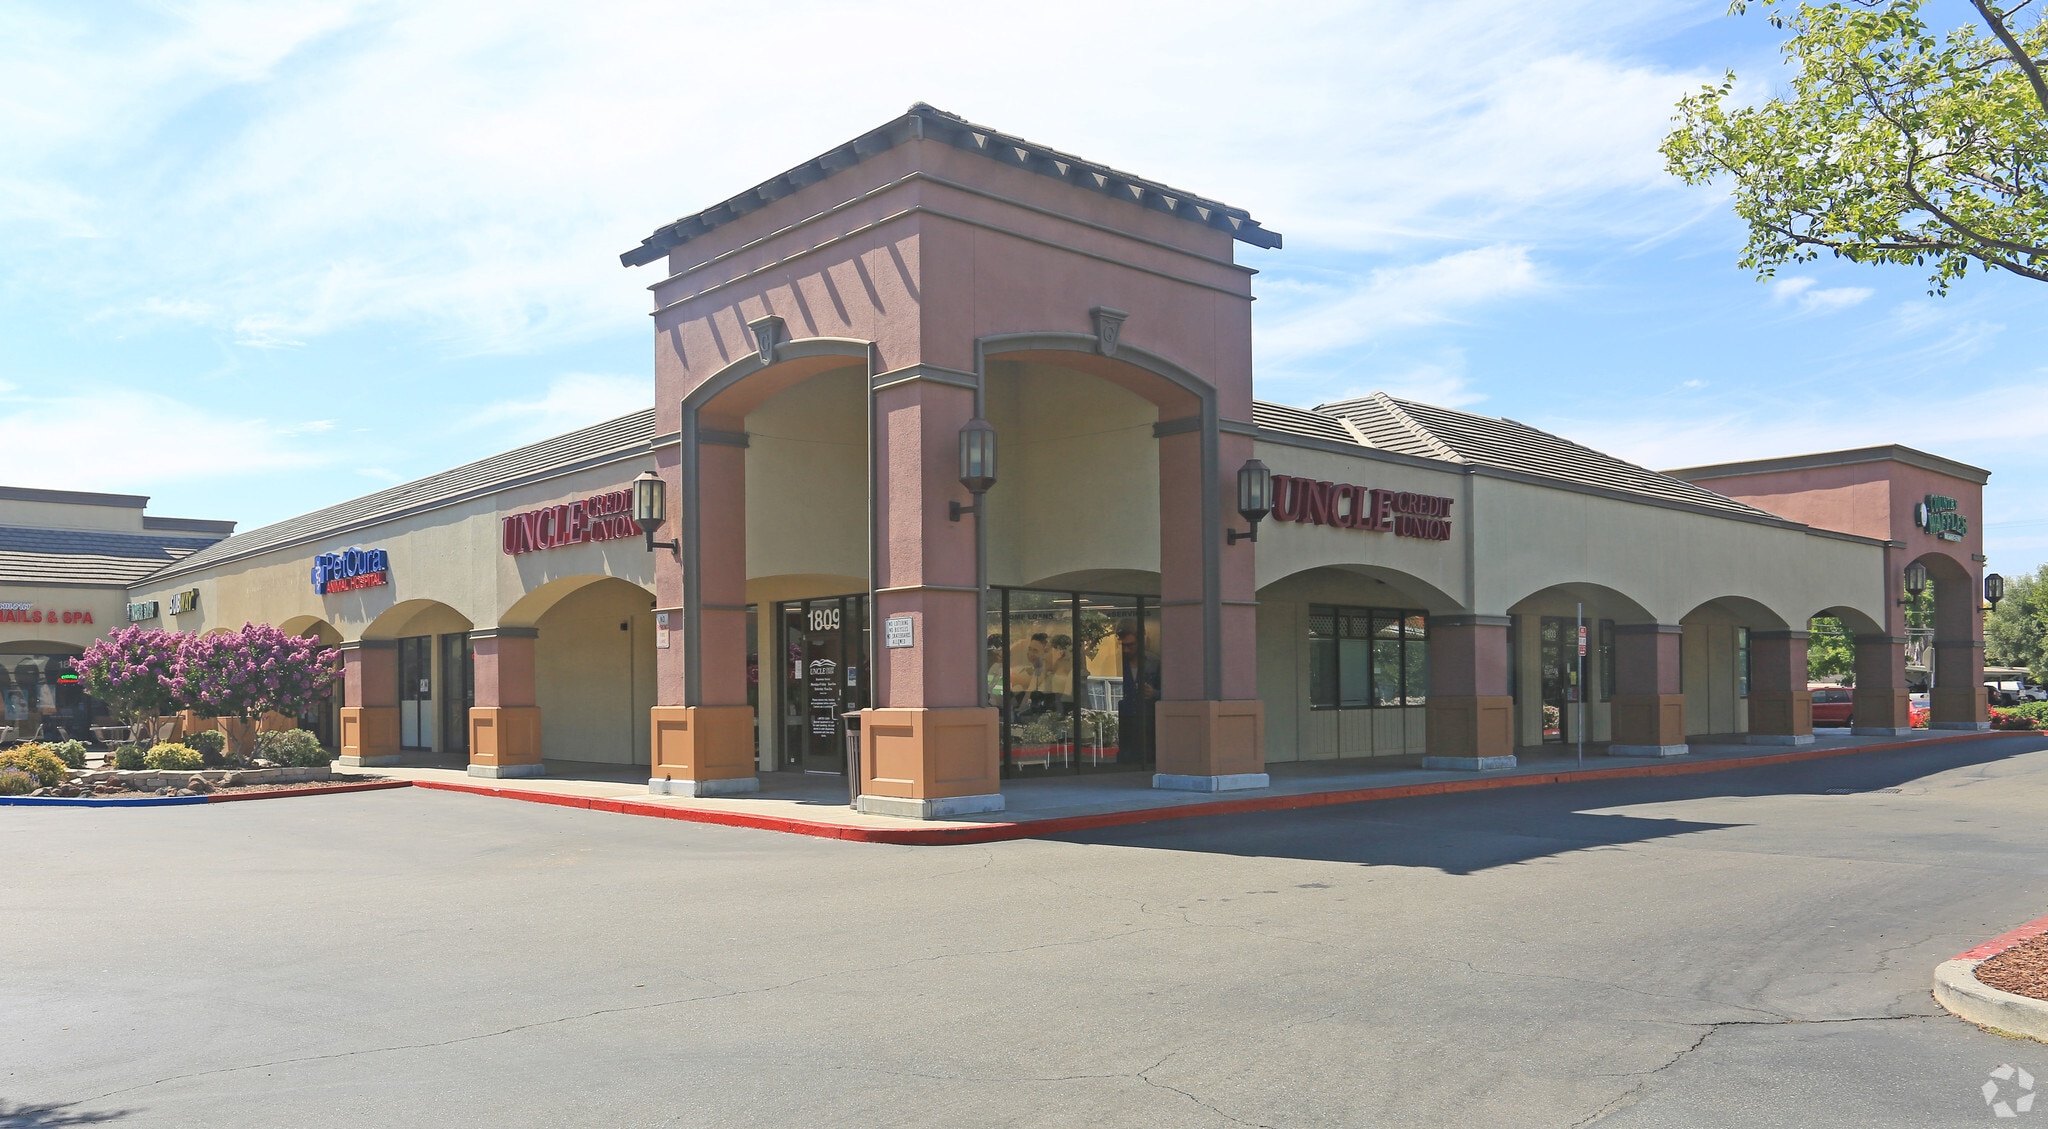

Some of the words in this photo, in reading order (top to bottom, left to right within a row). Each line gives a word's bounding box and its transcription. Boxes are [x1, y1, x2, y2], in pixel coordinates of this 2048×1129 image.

[1271, 474, 1394, 532] UNCLE
[1396, 491, 1454, 517] CREDIT
[502, 499, 586, 556] UNCLE
[1397, 514, 1452, 541] UNION
[1927, 511, 1968, 537] WAFFLES
[326, 546, 384, 581] PetCura
[326, 578, 349, 593] ANIMAL
[350, 571, 383, 590] HOSPITAL
[169, 588, 198, 615] SUBWAY
[47, 611, 59, 624] &
[62, 611, 94, 625] SPA
[808, 608, 840, 631] 1809
